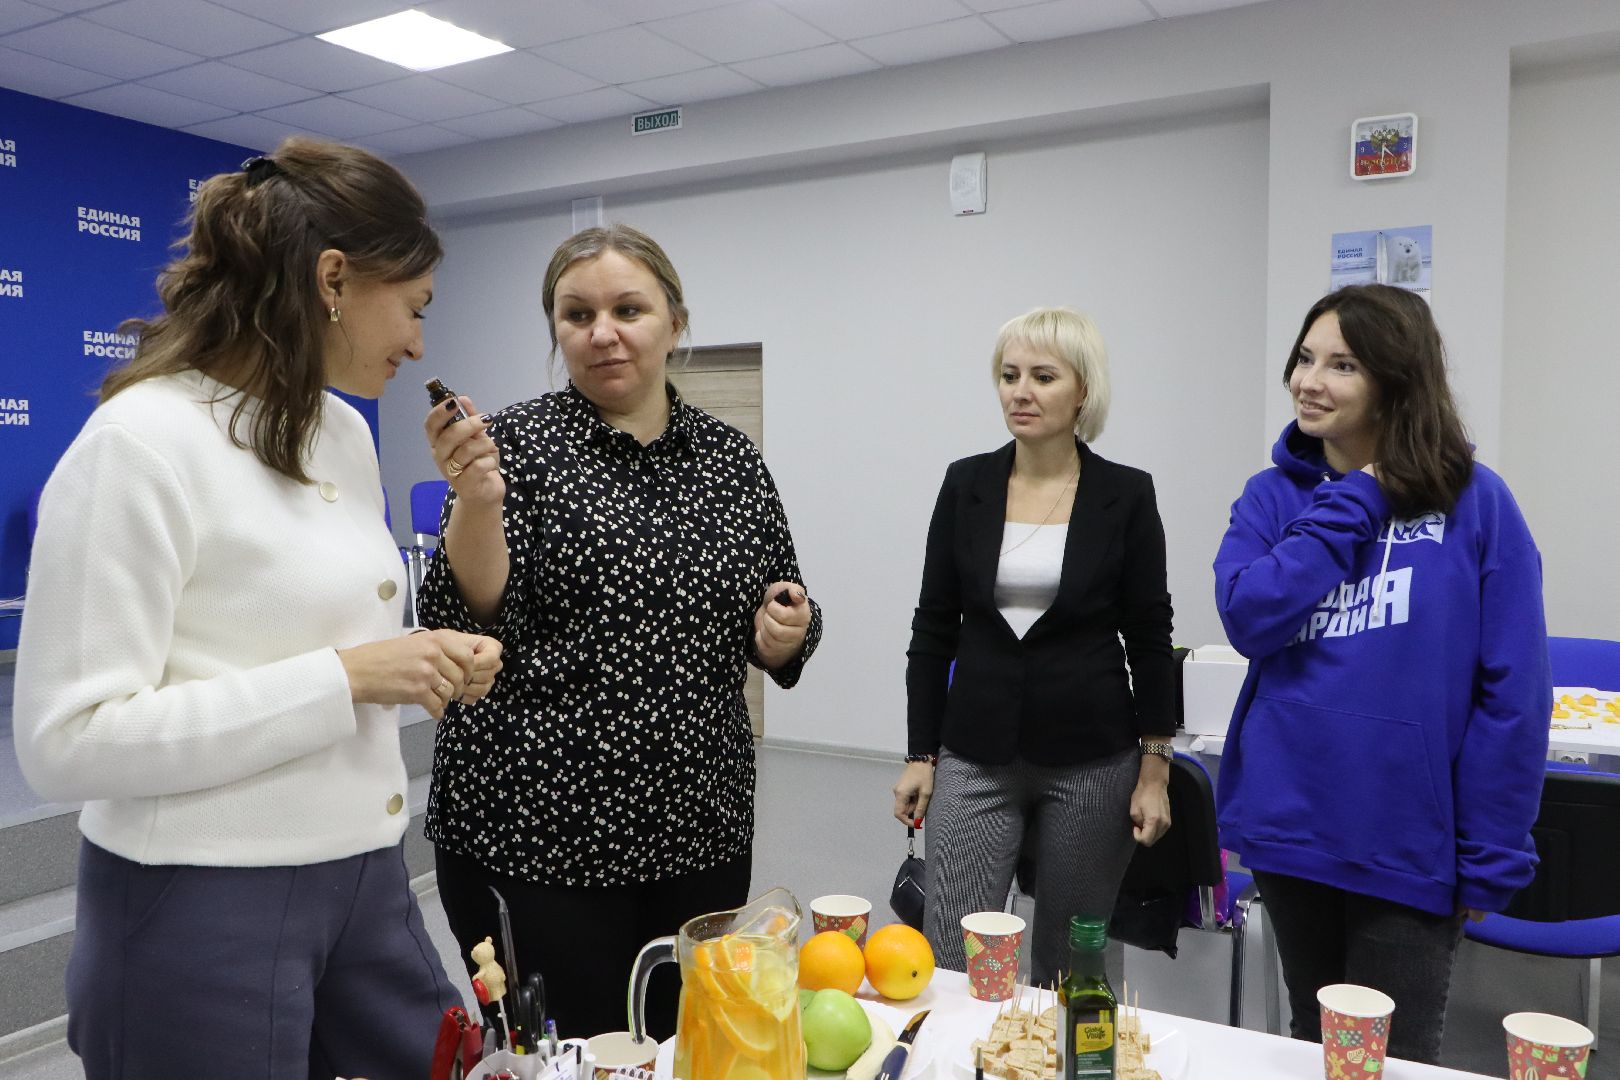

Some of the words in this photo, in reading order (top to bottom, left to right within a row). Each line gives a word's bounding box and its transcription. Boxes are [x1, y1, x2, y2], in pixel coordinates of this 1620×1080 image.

[637, 113, 678, 130] ВЫХОД
[77, 206, 140, 228] ЕДИНАЯ
[78, 220, 141, 241] РОССИЯ
[84, 344, 136, 359] РОССИ
